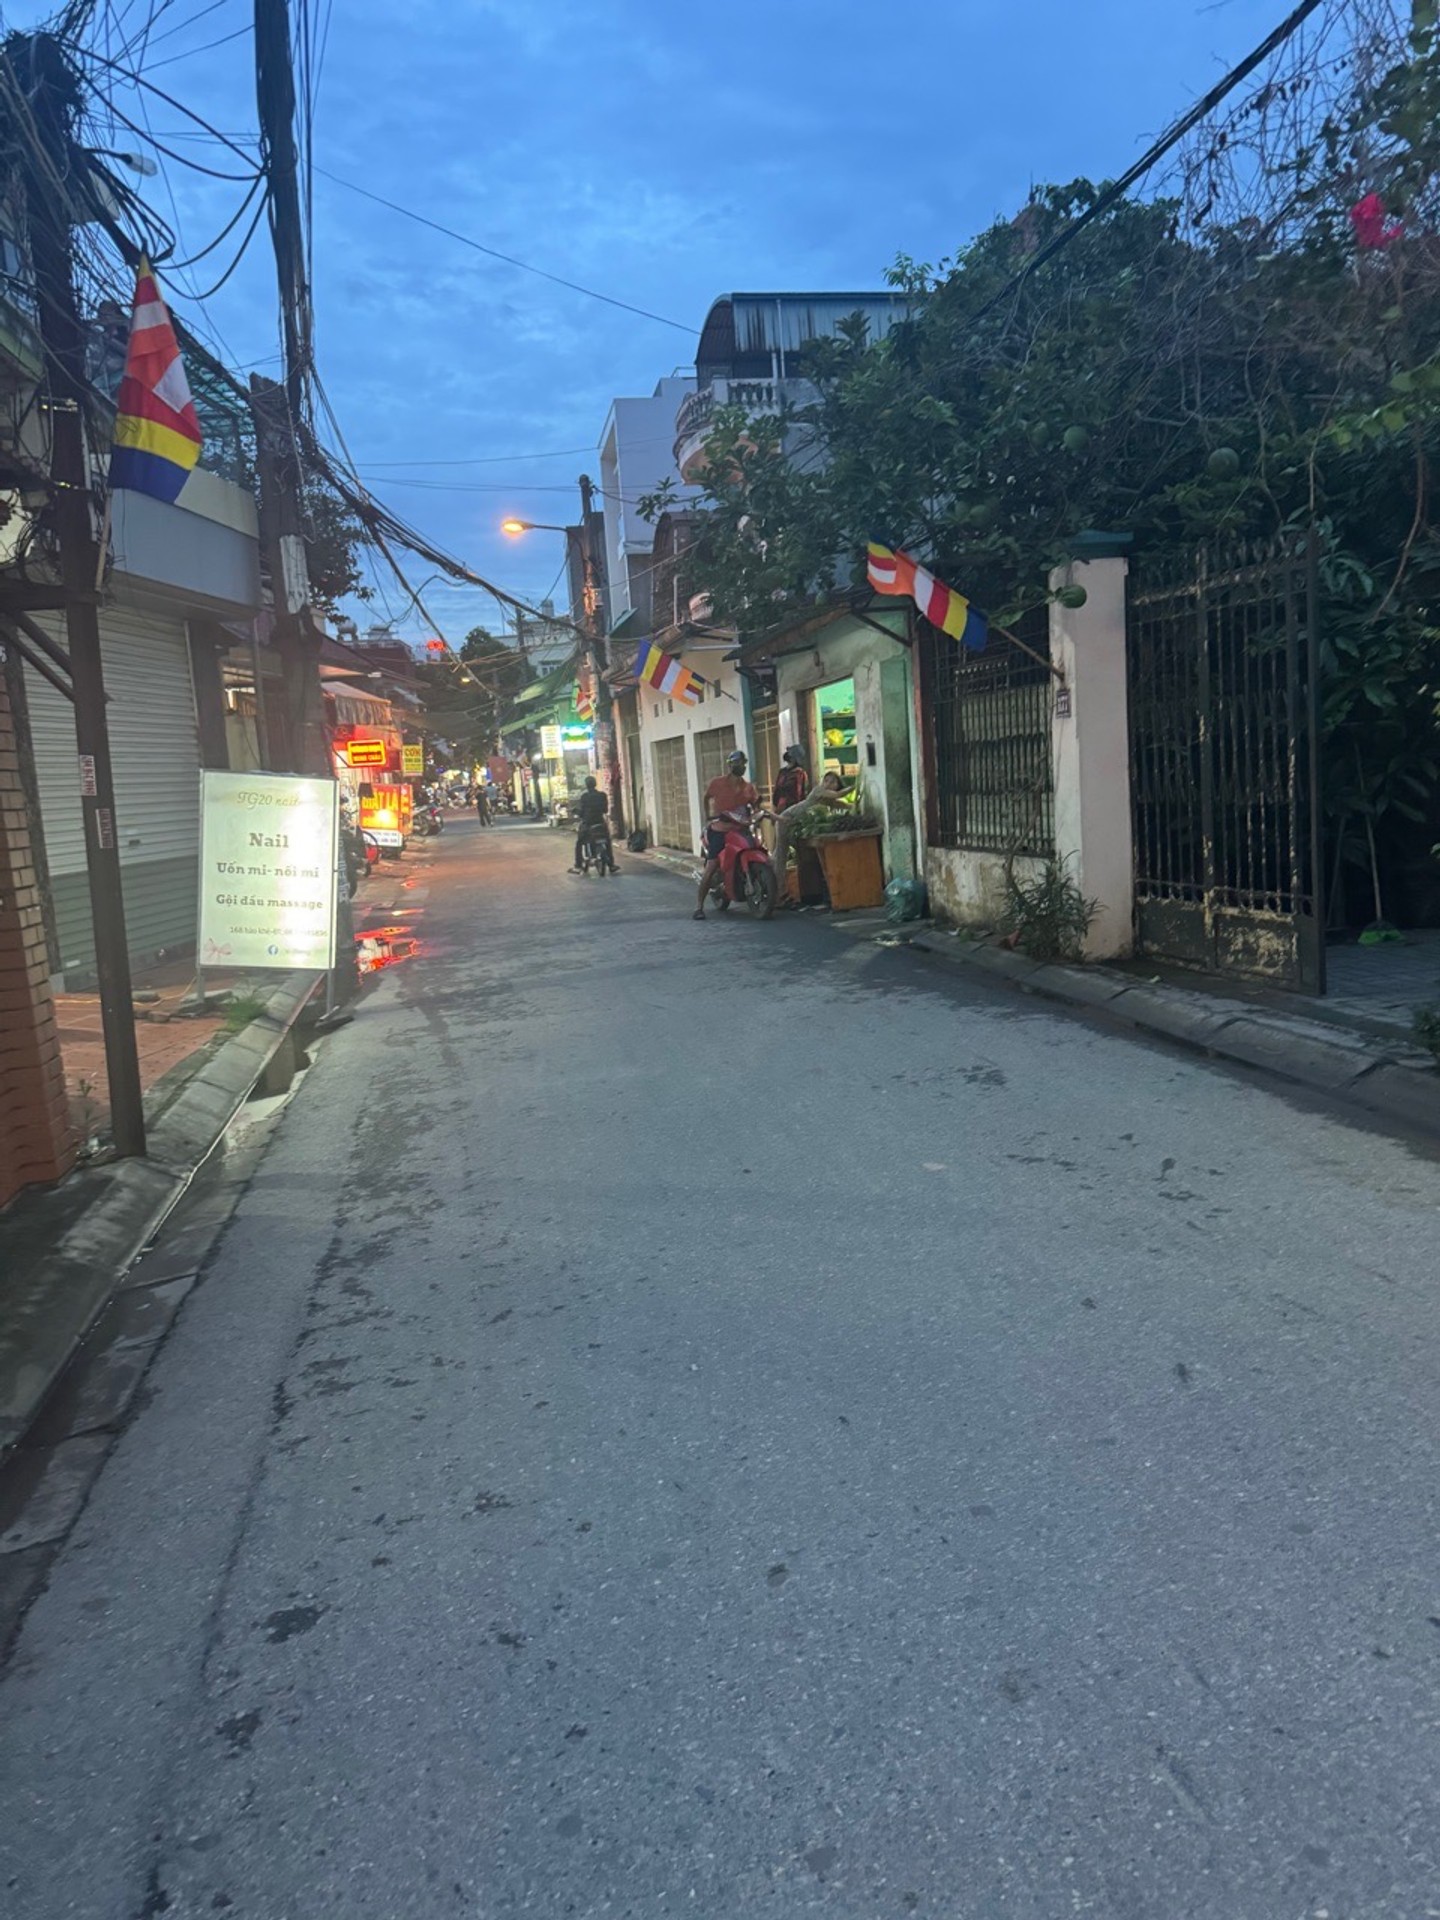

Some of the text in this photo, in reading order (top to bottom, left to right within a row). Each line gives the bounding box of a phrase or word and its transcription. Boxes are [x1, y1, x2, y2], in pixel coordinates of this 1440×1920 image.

[249, 833, 289, 848] Nail
[216, 860, 245, 874] Uốn
[300, 867, 319, 878] mi
[216, 894, 237, 907] Gội
[267, 899, 324, 910] massage
